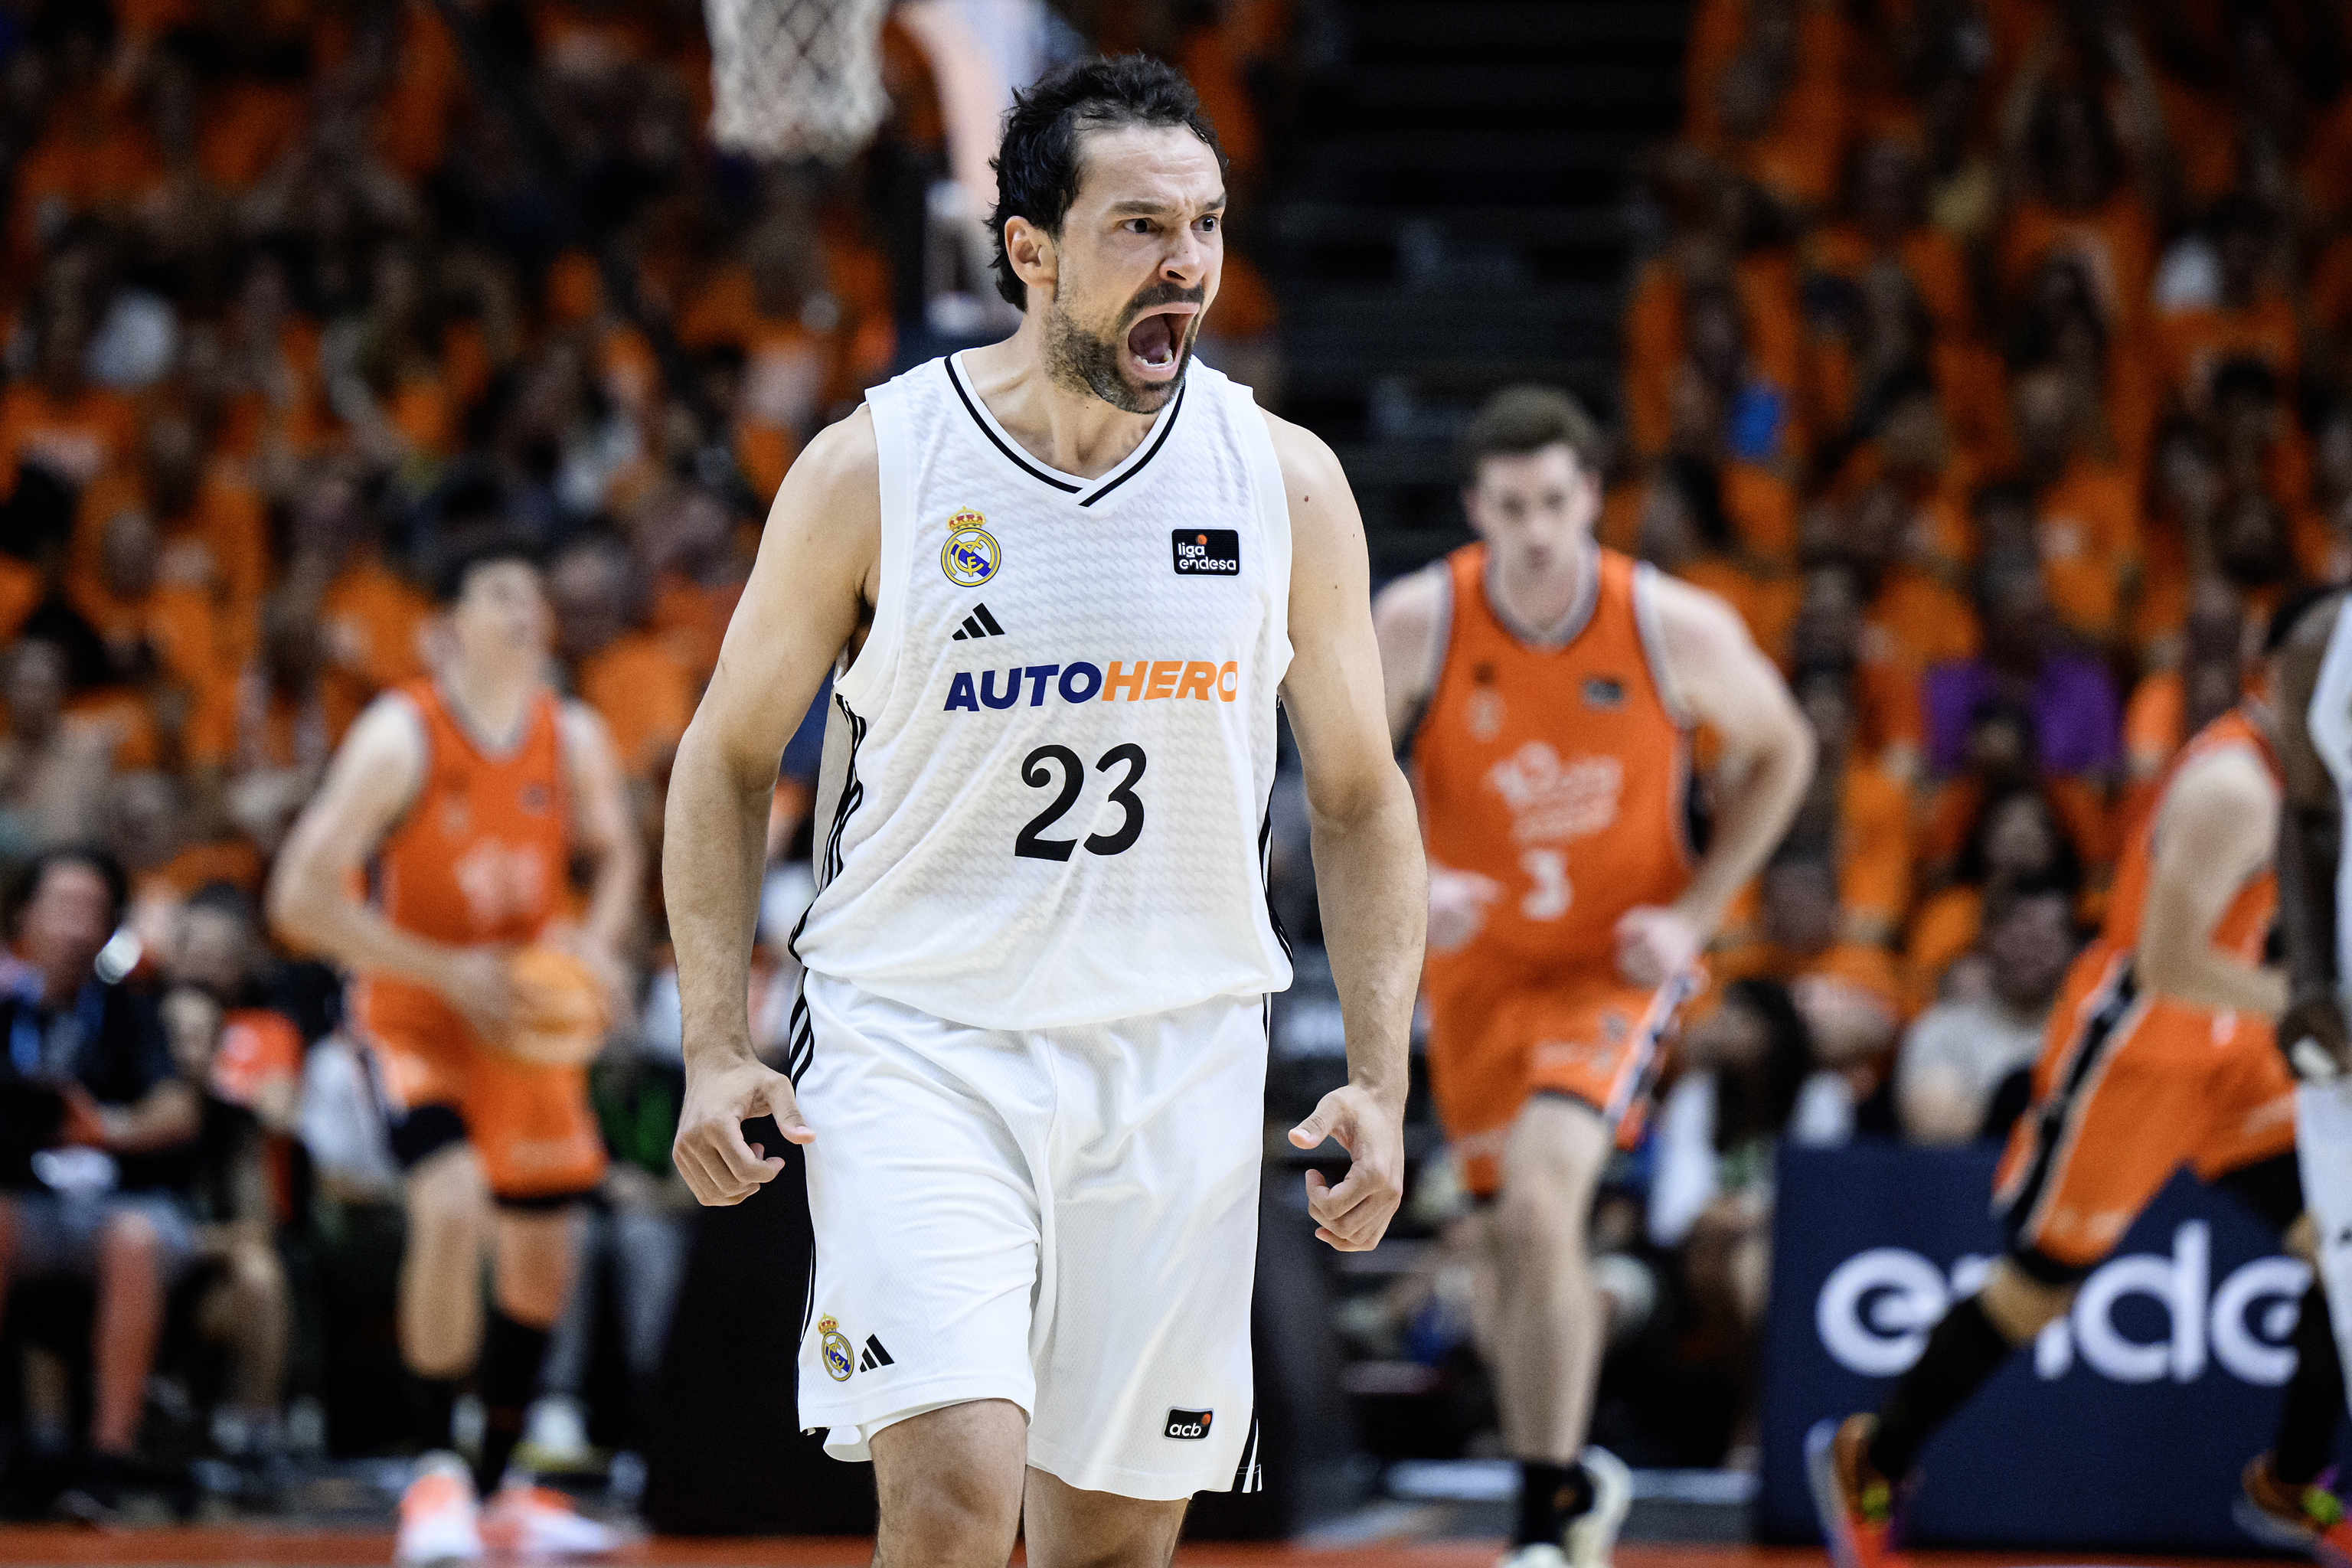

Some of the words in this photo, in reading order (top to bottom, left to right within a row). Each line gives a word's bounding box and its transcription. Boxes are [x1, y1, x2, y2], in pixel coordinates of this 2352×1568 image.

[1178, 542, 1205, 558] liga
[1179, 556, 1236, 570] endesa
[1014, 743, 1147, 862] 23
[1518, 849, 1574, 921] 3
[1169, 1423, 1202, 1436] acb
